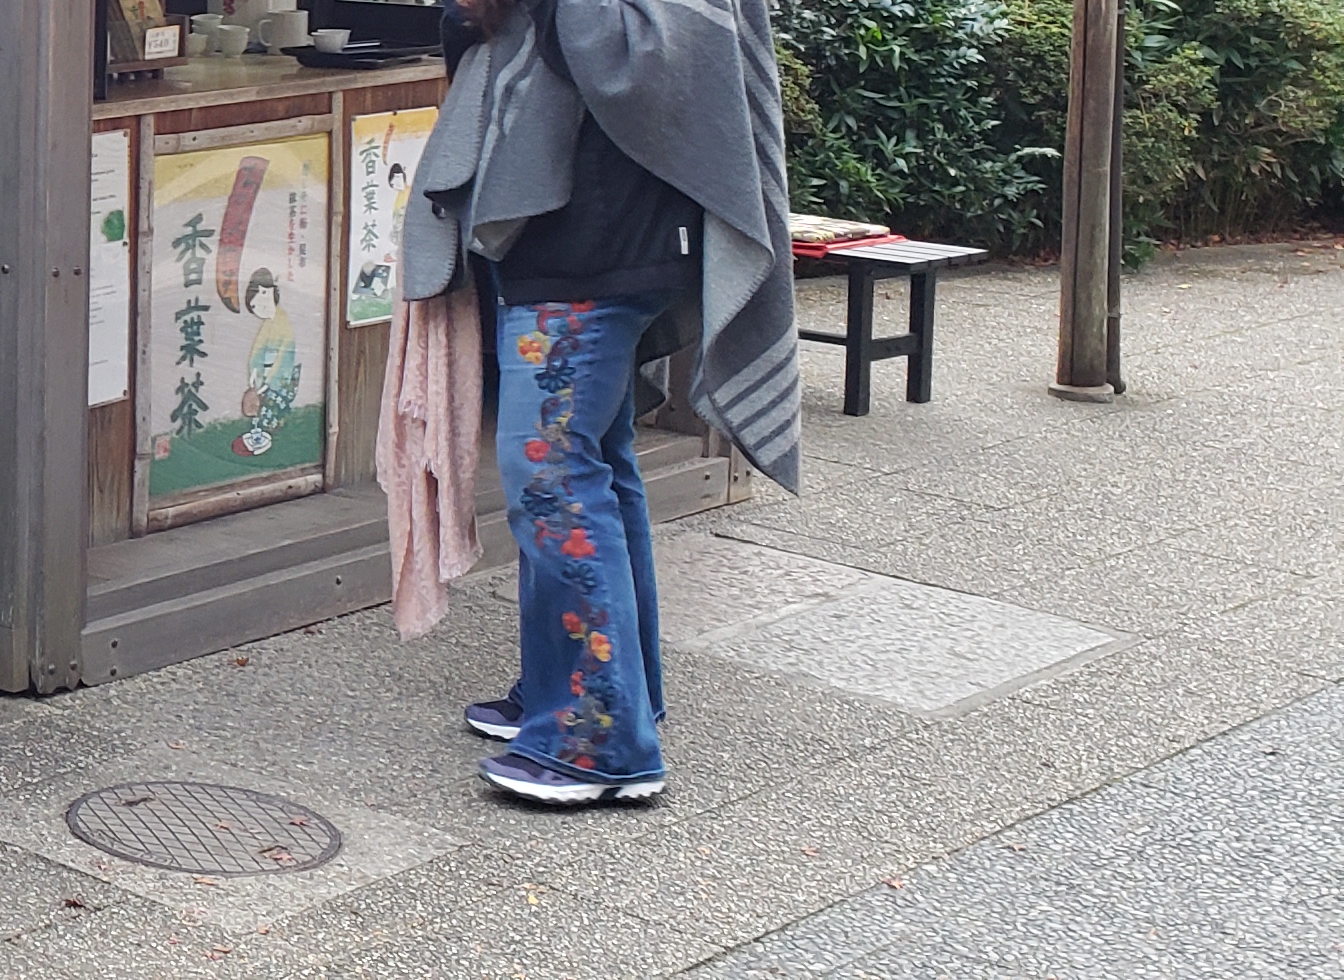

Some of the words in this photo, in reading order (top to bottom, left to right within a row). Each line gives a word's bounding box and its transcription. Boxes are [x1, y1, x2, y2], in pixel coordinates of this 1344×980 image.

[359, 136, 382, 253] 香葉茶
[170, 213, 216, 437] 香葉茶
